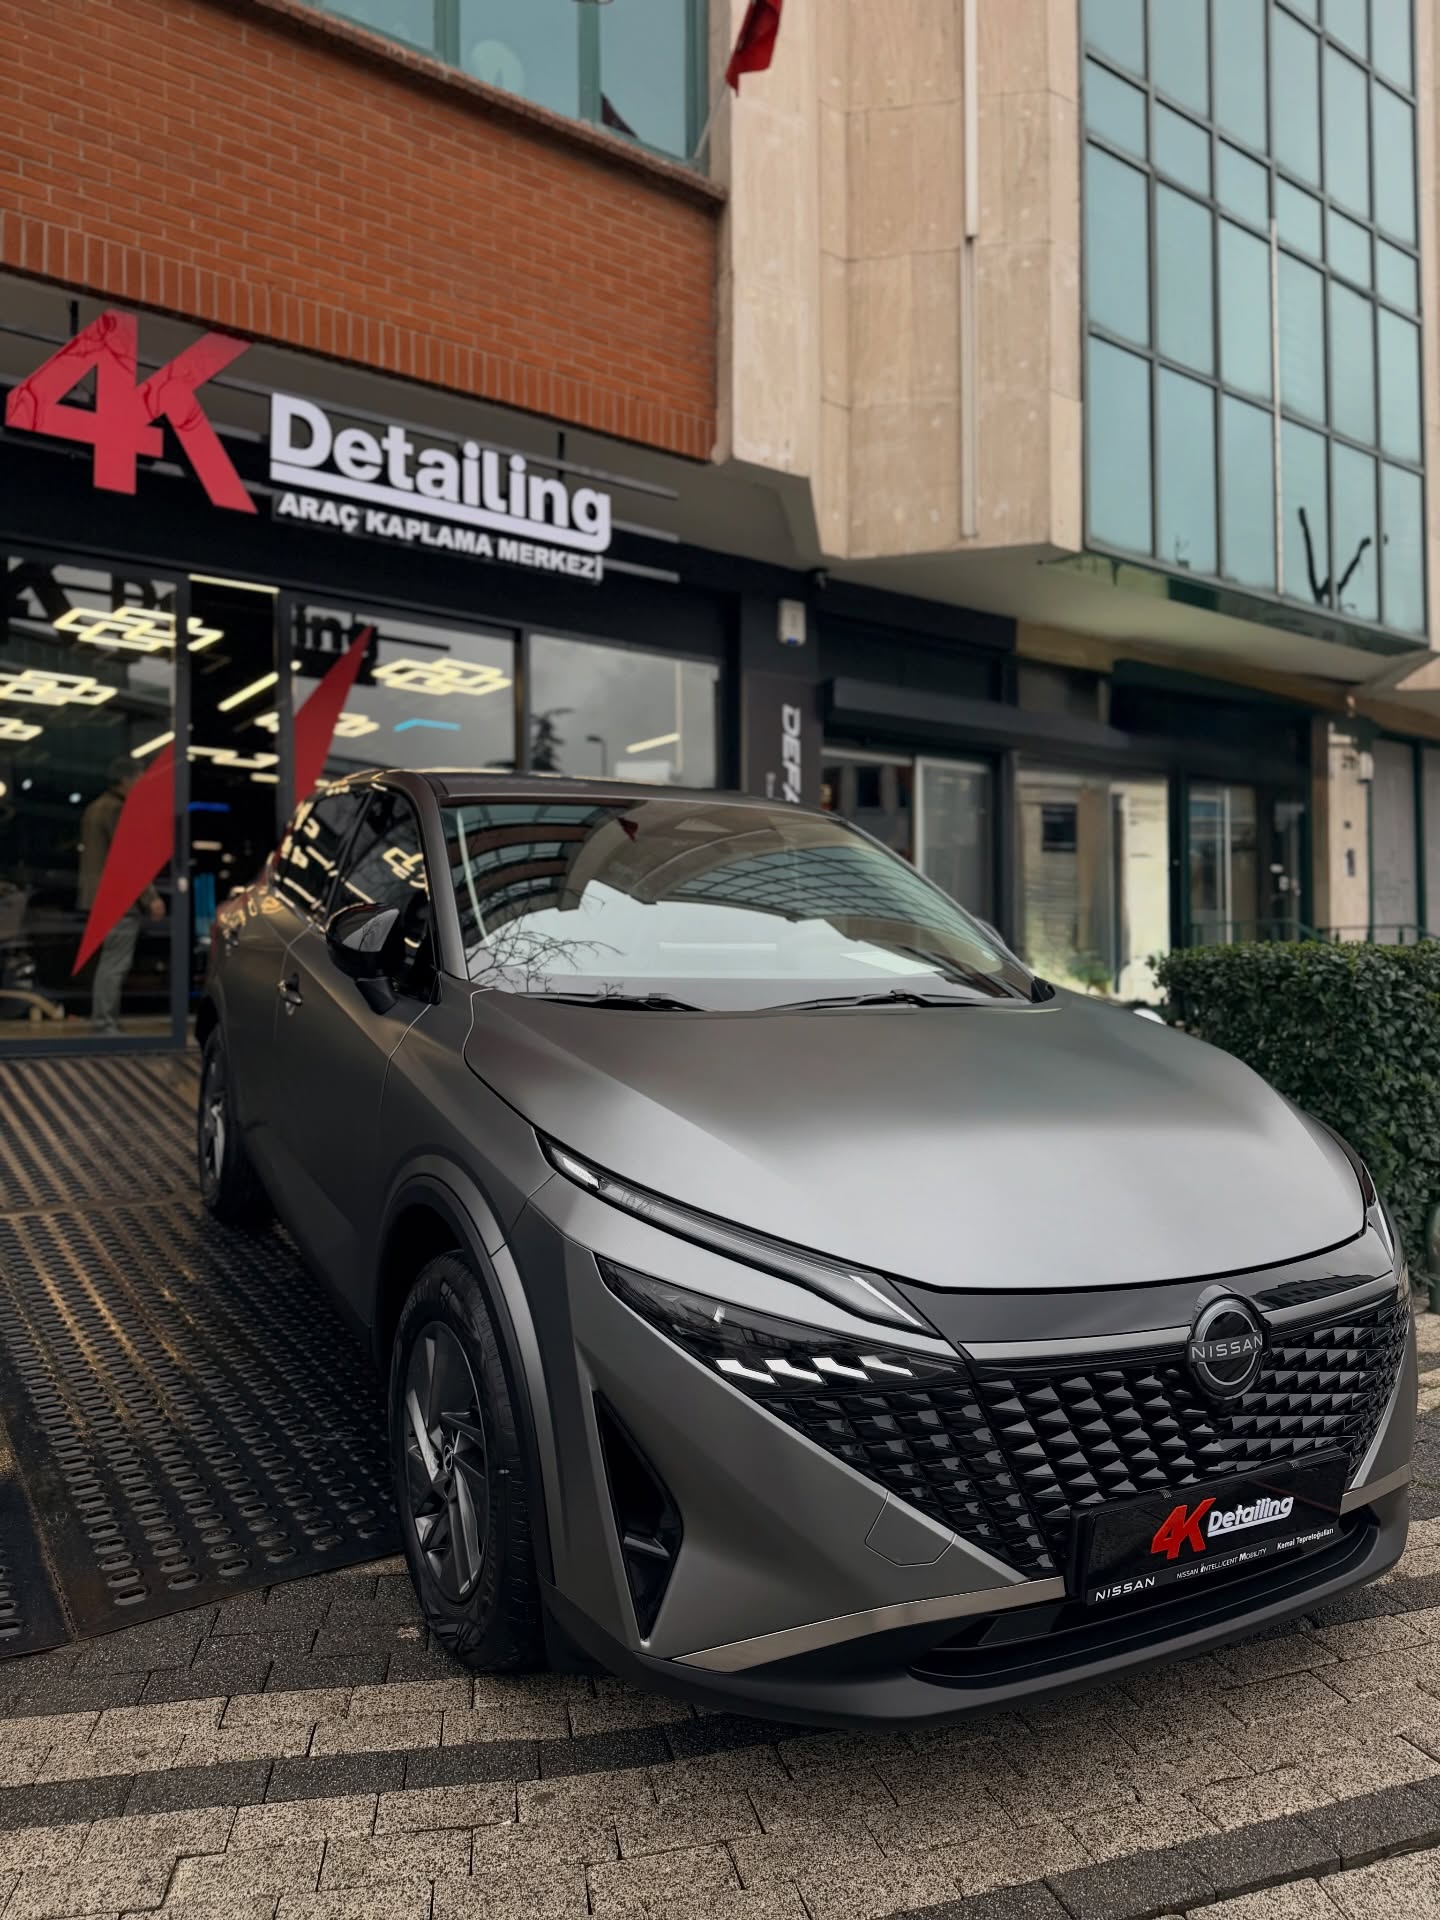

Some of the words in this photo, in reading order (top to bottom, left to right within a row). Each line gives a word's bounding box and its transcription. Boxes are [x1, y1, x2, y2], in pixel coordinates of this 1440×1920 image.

[5, 308, 256, 514] 4K
[270, 391, 611, 552] Detailing
[278, 493, 360, 532] ARAÇ
[365, 510, 494, 558] KAPLAMA
[1191, 1334, 1263, 1359] NISSAN
[1151, 1497, 1216, 1560] 4K
[1207, 1496, 1294, 1538] Detailing
[1276, 1538, 1295, 1550] Kemal
[1176, 1568, 1199, 1580] NISSAN
[1095, 1576, 1155, 1602] NISSAN
